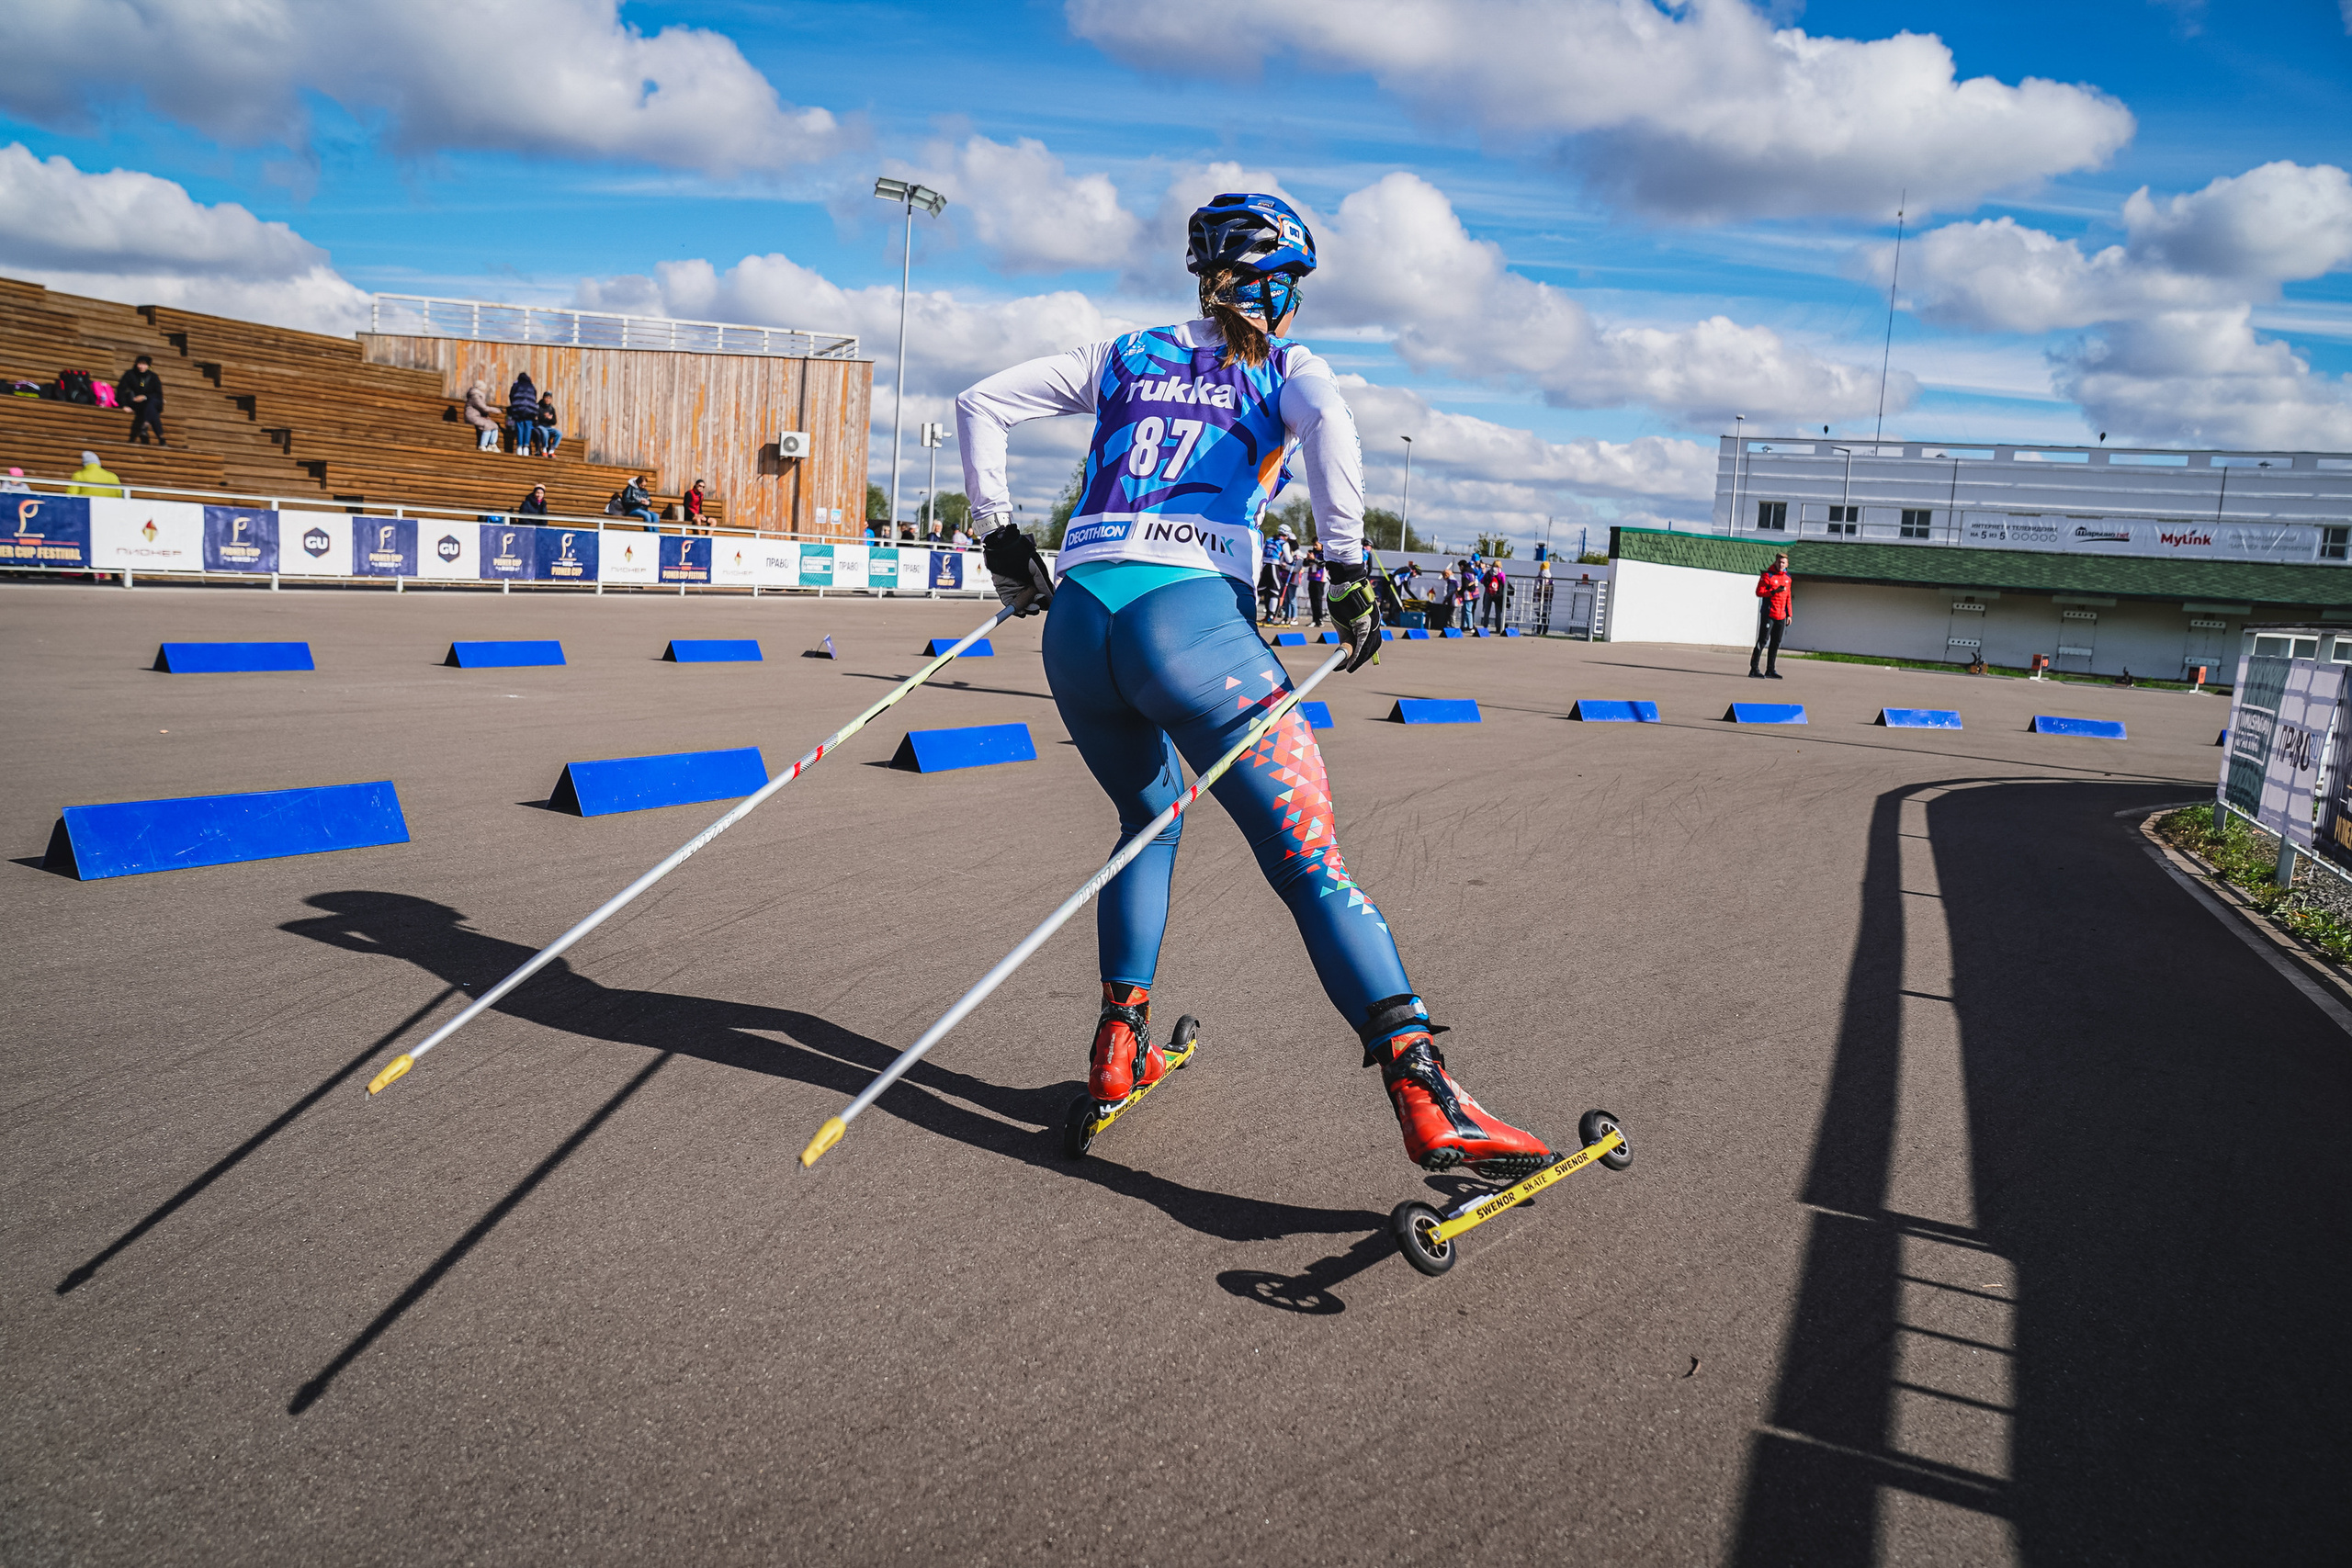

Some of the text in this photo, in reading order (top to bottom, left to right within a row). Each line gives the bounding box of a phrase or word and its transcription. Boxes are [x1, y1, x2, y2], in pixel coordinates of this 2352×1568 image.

[1125, 376, 1237, 410] rukka
[1128, 416, 1204, 479] 87
[305, 536, 328, 550] GU
[1068, 525, 1126, 547] DECATHLON
[1144, 523, 1236, 558] INOVIK
[1981, 531, 1987, 539] 5
[1999, 532, 2006, 540] 5
[15, 546, 37, 558] CUP
[37, 547, 83, 560] FESTIVAL
[439, 542, 458, 555] GU
[766, 558, 789, 569] ПРАВО
[839, 561, 859, 571] ПРАВО
[2276, 725, 2311, 772] ПРАВО
[1079, 852, 1125, 908] AVANTI
[1476, 1152, 1589, 1220] SWENOR SKATE SWENOR
